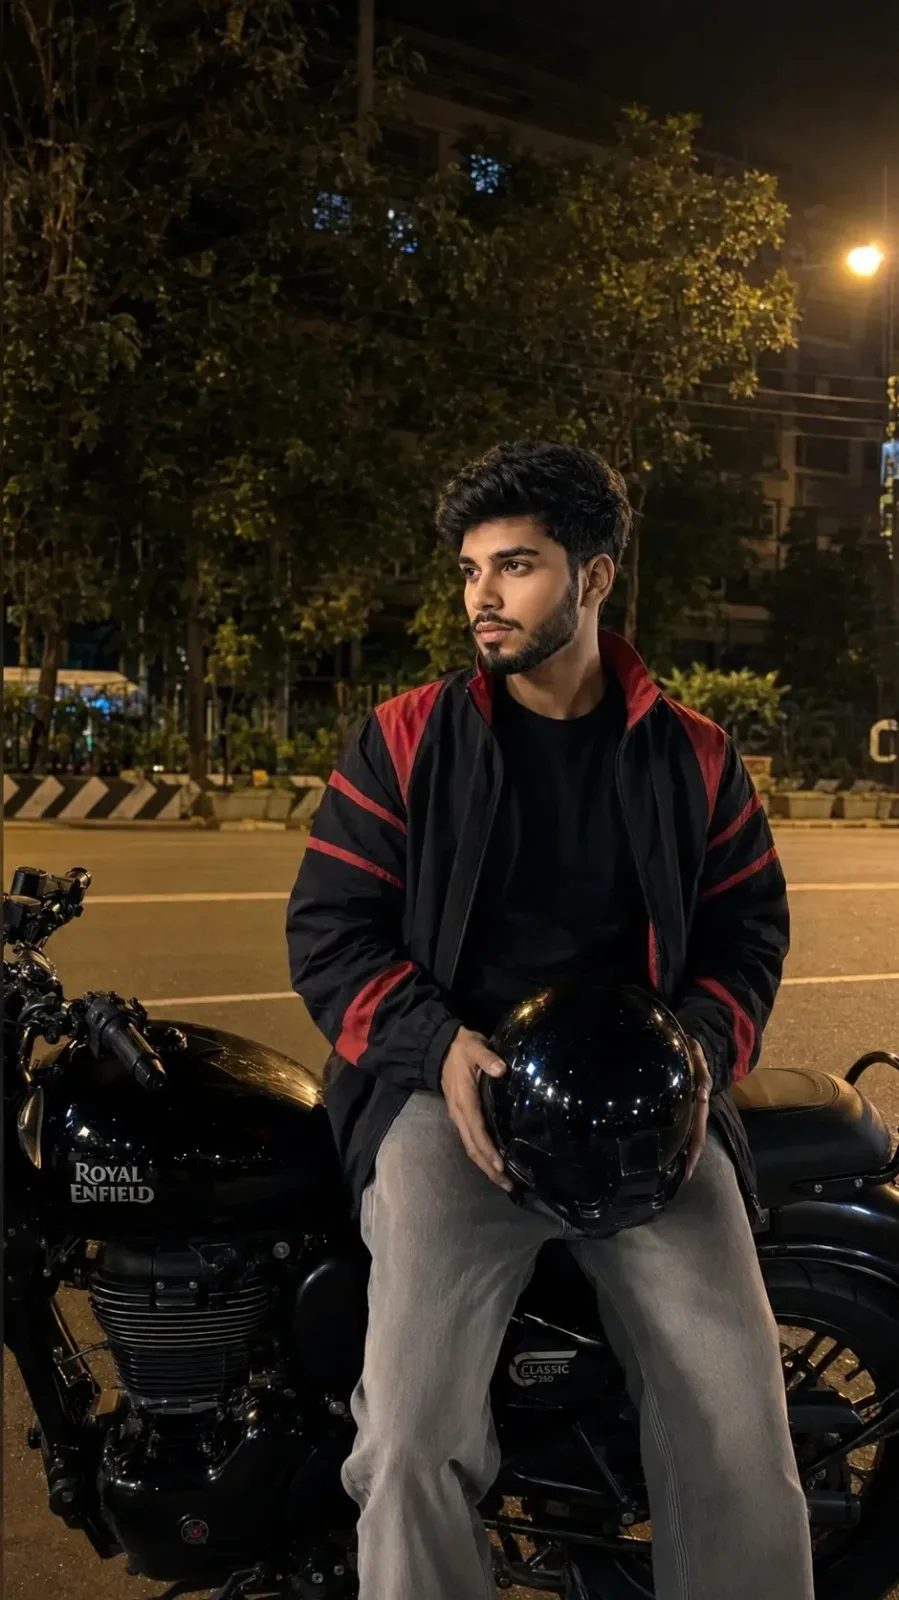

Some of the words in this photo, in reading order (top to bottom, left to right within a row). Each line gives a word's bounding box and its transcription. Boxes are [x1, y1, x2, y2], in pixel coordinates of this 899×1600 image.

[75, 1162, 143, 1185] ROYAL
[70, 1183, 155, 1204] ENFIELD
[521, 1364, 570, 1375] CLASSIC
[538, 1375, 554, 1383] 350
